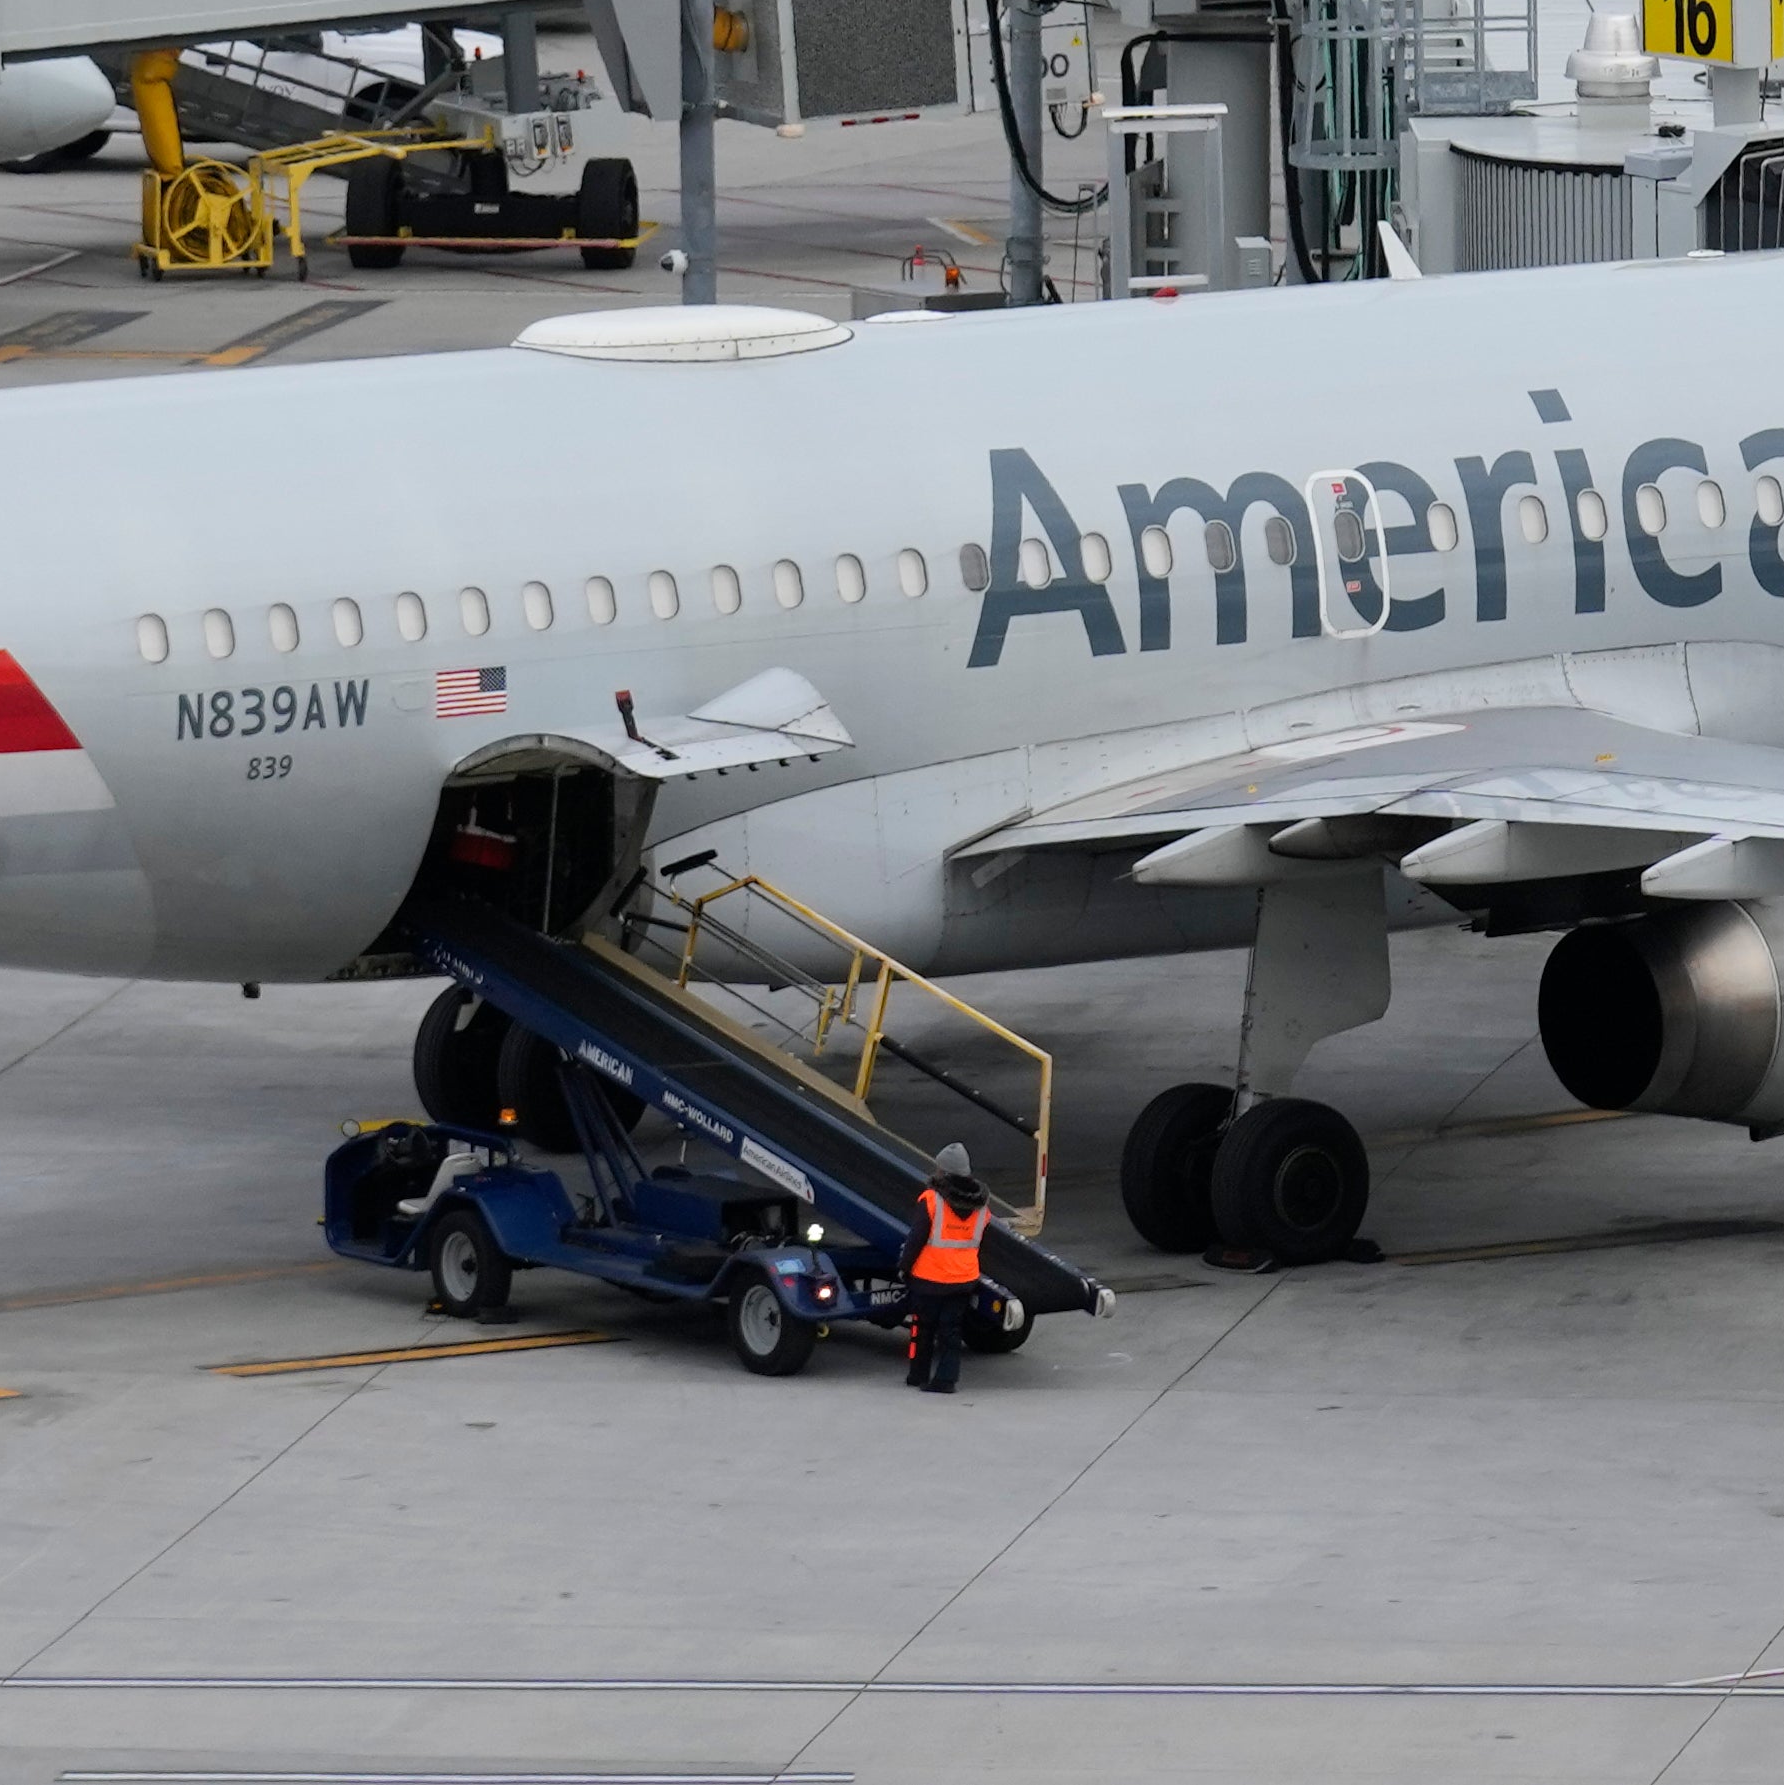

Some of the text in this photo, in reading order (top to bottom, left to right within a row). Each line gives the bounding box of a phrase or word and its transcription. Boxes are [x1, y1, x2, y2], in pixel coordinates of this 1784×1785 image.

[177, 678, 370, 742] N839AW
[247, 754, 294, 780] 839
[577, 1039, 634, 1085] AMERICAN
